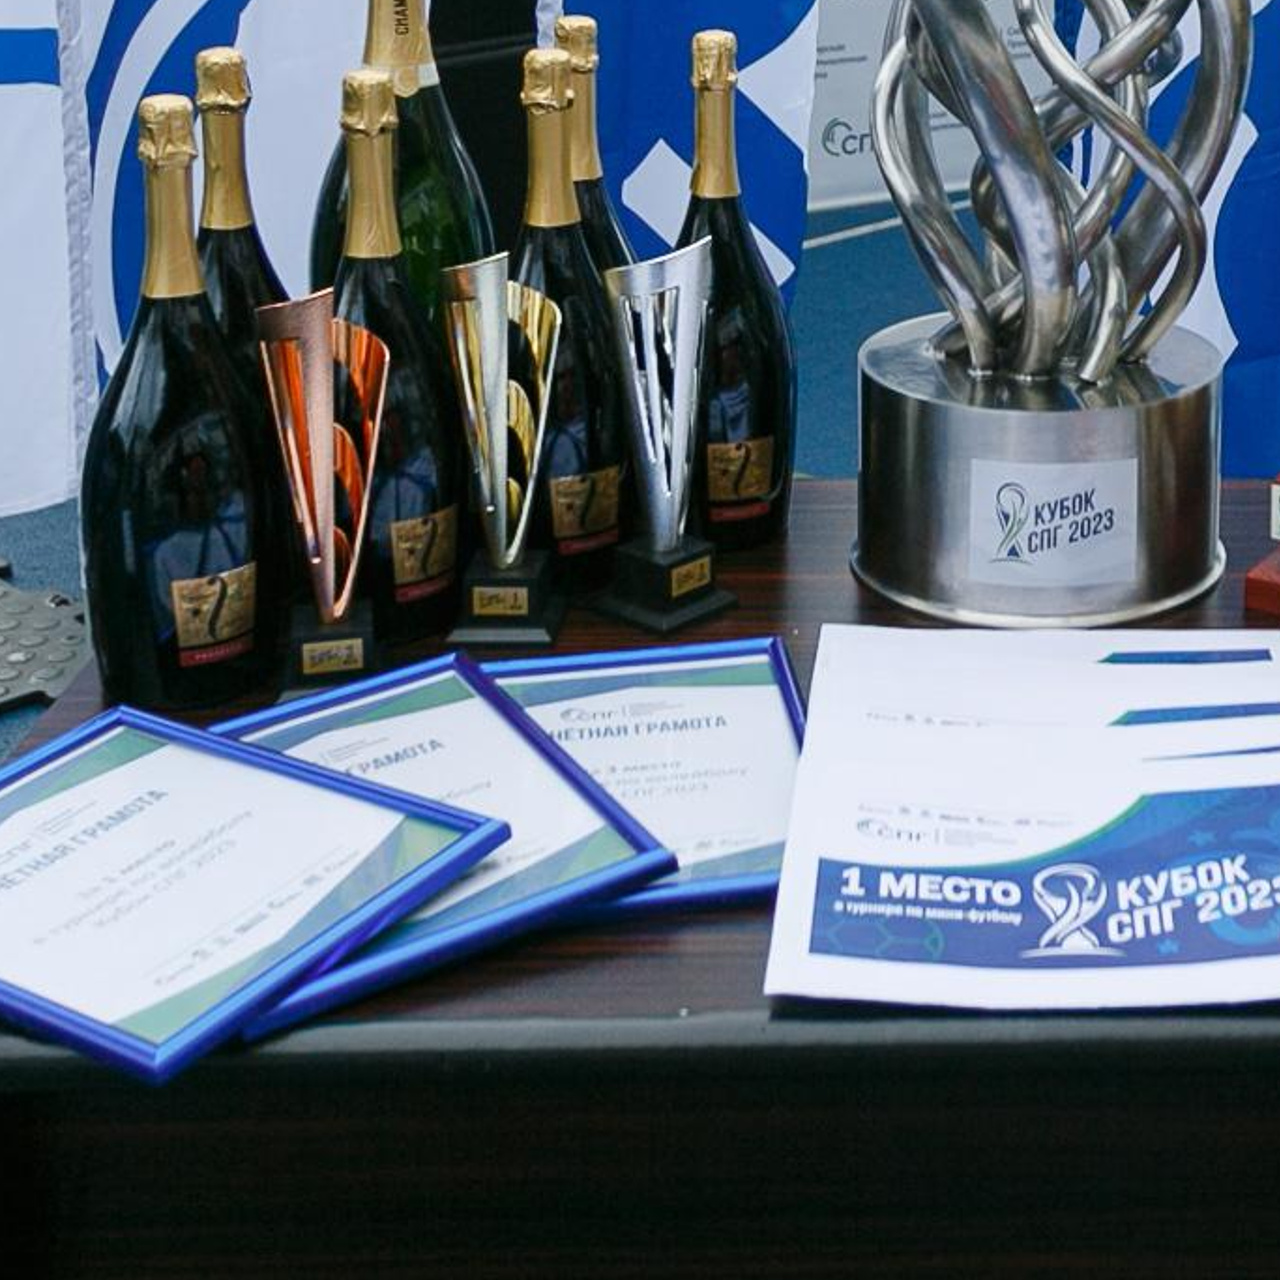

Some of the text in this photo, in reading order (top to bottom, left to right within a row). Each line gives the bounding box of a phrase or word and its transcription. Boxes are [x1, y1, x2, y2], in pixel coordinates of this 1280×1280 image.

[1034, 487, 1096, 527] КУБОК
[1027, 507, 1115, 554] СПГ 2023
[840, 866, 1022, 907] 1 МЕСТО
[1116, 853, 1250, 911] КУБОК
[1107, 897, 1184, 943] СПГ
